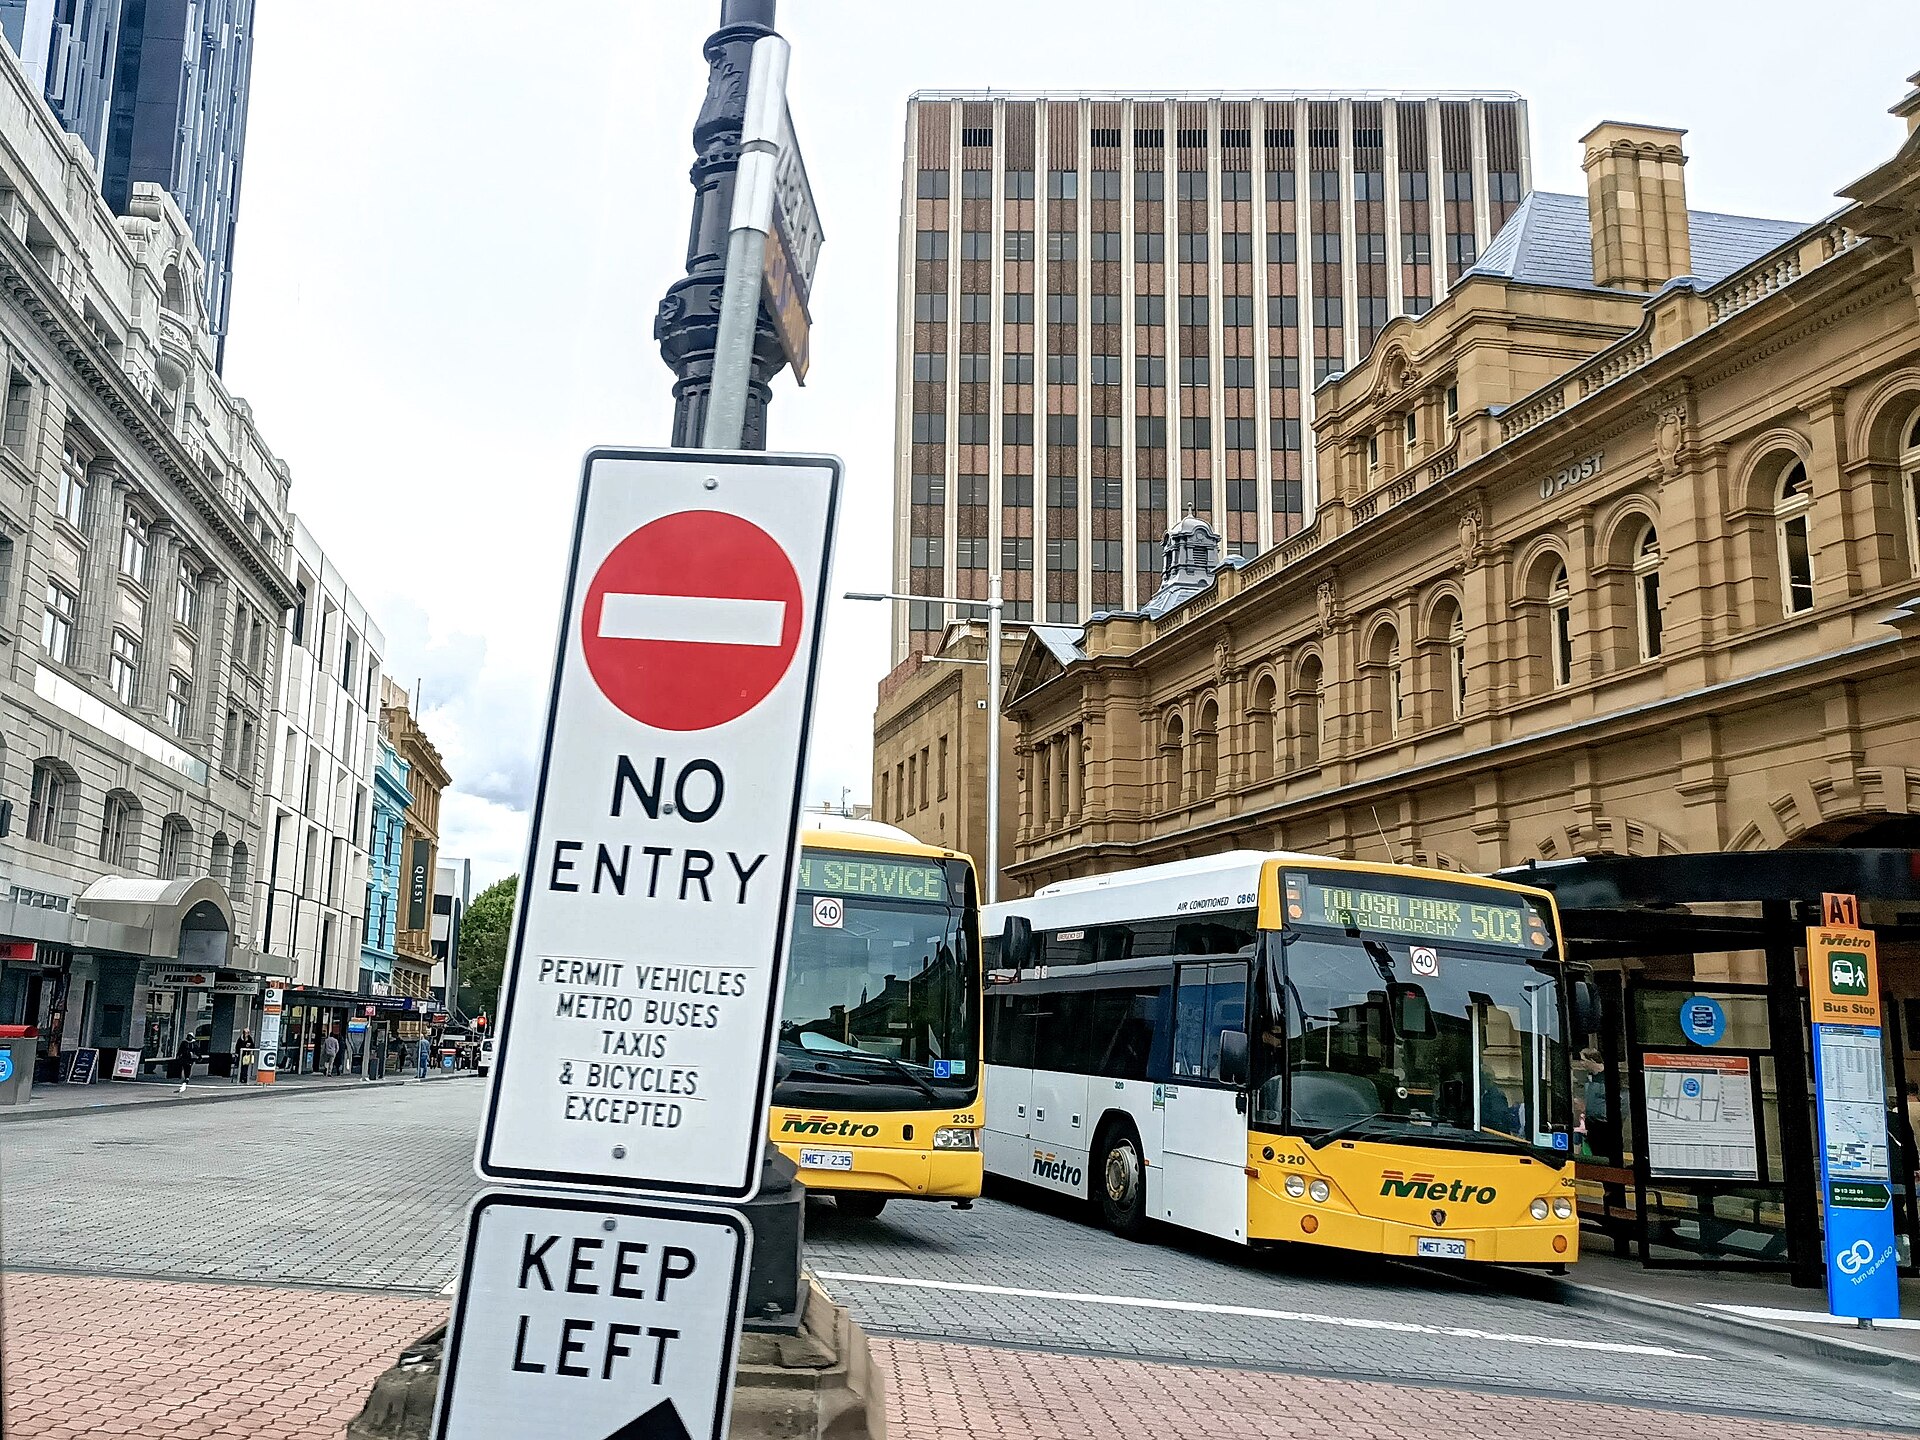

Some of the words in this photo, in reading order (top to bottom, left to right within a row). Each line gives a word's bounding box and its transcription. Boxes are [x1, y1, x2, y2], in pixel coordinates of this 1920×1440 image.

[1558, 451, 1603, 491] POST
[610, 755, 725, 823] NO
[414, 865, 424, 904] QUEST
[549, 840, 769, 904] ENTRY
[824, 861, 940, 897] SERVICE
[818, 905, 838, 919] 40
[1177, 902, 1188, 911] AIR
[1190, 897, 1229, 910] CONDITIONED
[1320, 888, 1399, 915] TOLOSA
[1409, 898, 1462, 923] PARK
[1471, 905, 1522, 943] 503
[1829, 895, 1855, 925] A1
[1325, 908, 1351, 925] VIA
[1356, 913, 1458, 937] GLENORCHY
[1820, 933, 1871, 948] Metro
[538, 958, 624, 988] PERMIT
[636, 965, 747, 997] VEHICLES
[1415, 955, 1433, 969] 40
[556, 993, 633, 1022] METRO
[643, 1000, 720, 1028] BUSES
[1823, 1002, 1848, 1013] Bus
[1851, 1003, 1876, 1016] Stop
[602, 1030, 667, 1058] TAXIS
[559, 1061, 574, 1085] &
[586, 1063, 699, 1095] BICYCLES
[564, 1095, 682, 1129] EXCEPTED
[781, 1113, 879, 1138] Metro
[952, 1114, 975, 1124] 235
[1032, 1147, 1082, 1186] Metro
[1277, 1153, 1305, 1166] 320
[1380, 1169, 1497, 1204] Metro
[517, 1233, 698, 1302] KEEP
[1836, 1239, 1874, 1275] GO
[1851, 1272, 1868, 1286] Turn
[1866, 1266, 1876, 1277] up
[1875, 1255, 1885, 1268] and
[1884, 1246, 1893, 1259] GO
[511, 1315, 682, 1386] LEFT
